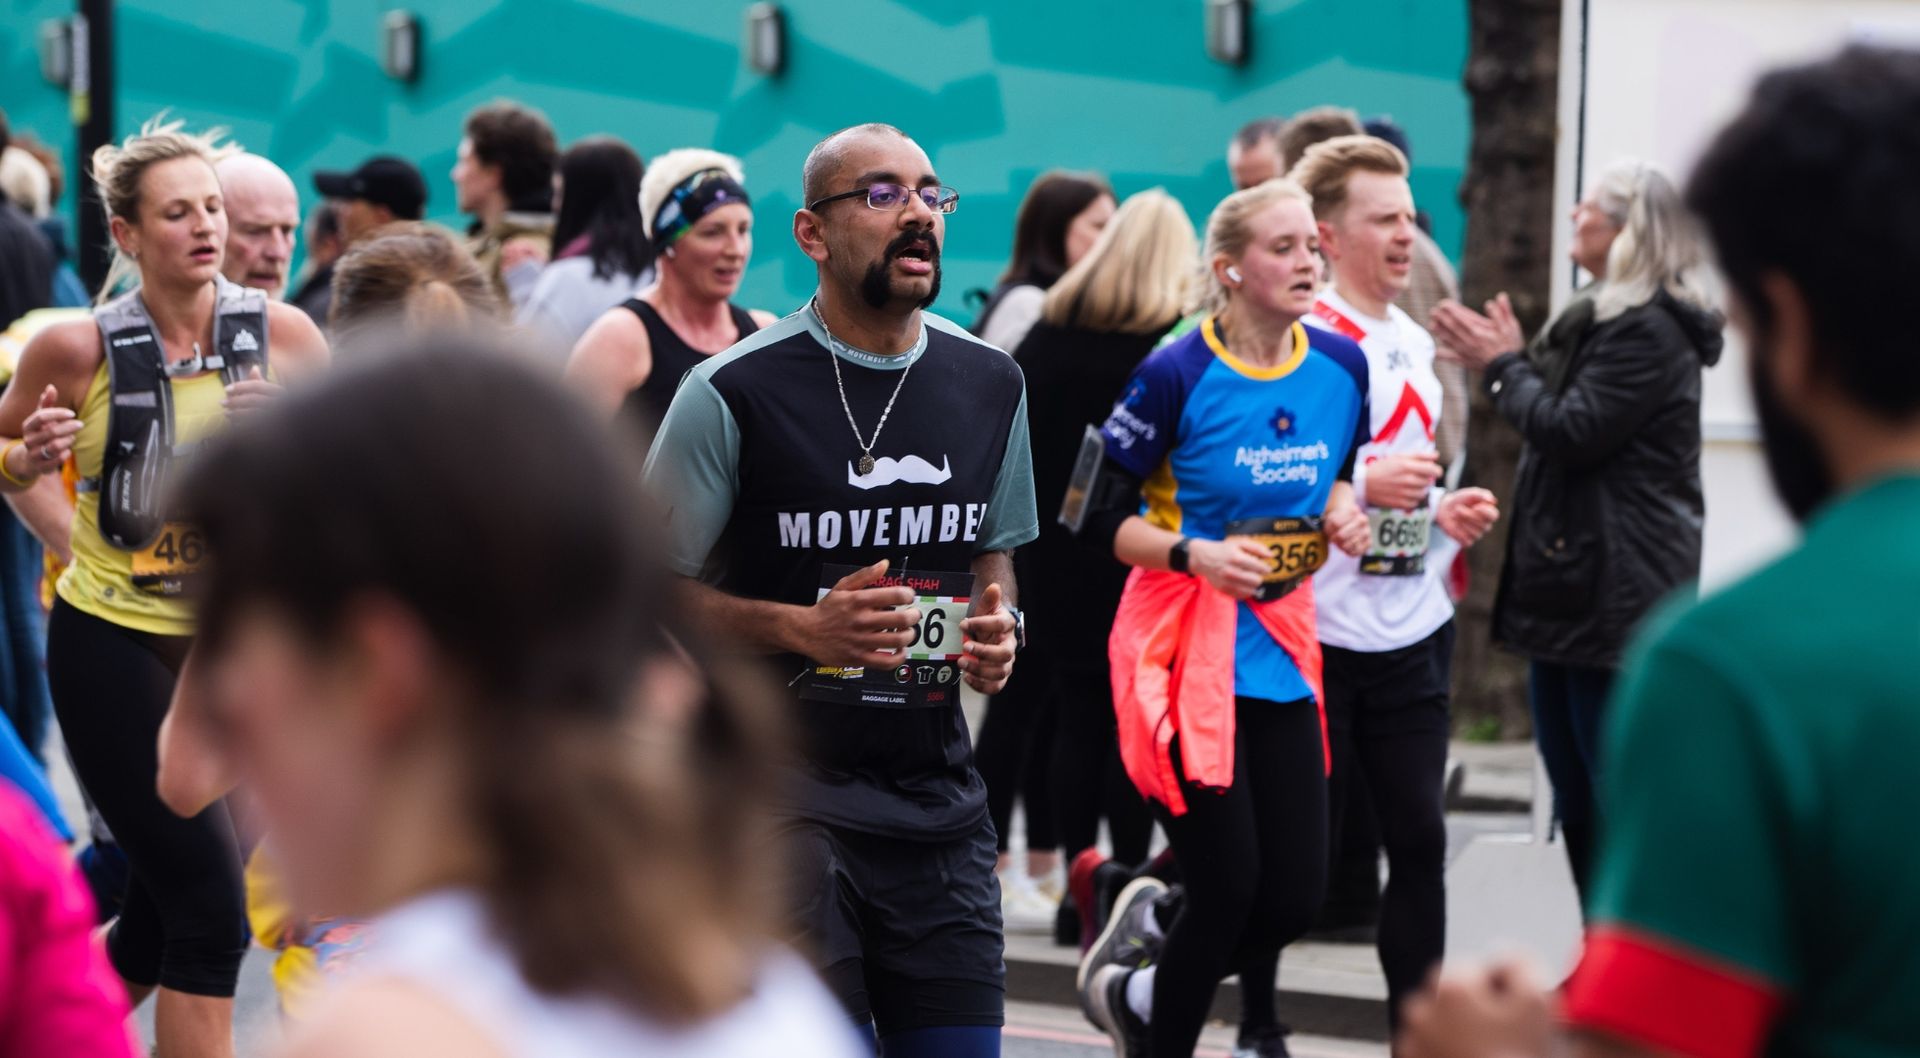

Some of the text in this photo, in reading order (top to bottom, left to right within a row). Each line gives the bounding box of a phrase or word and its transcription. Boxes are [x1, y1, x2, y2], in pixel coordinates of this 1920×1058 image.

[1234, 439, 1330, 466] Alzheimer's
[1250, 463, 1318, 486] Society
[865, 576, 940, 590] ARAG SHAH
[861, 695, 889, 703] BAGGAGE
